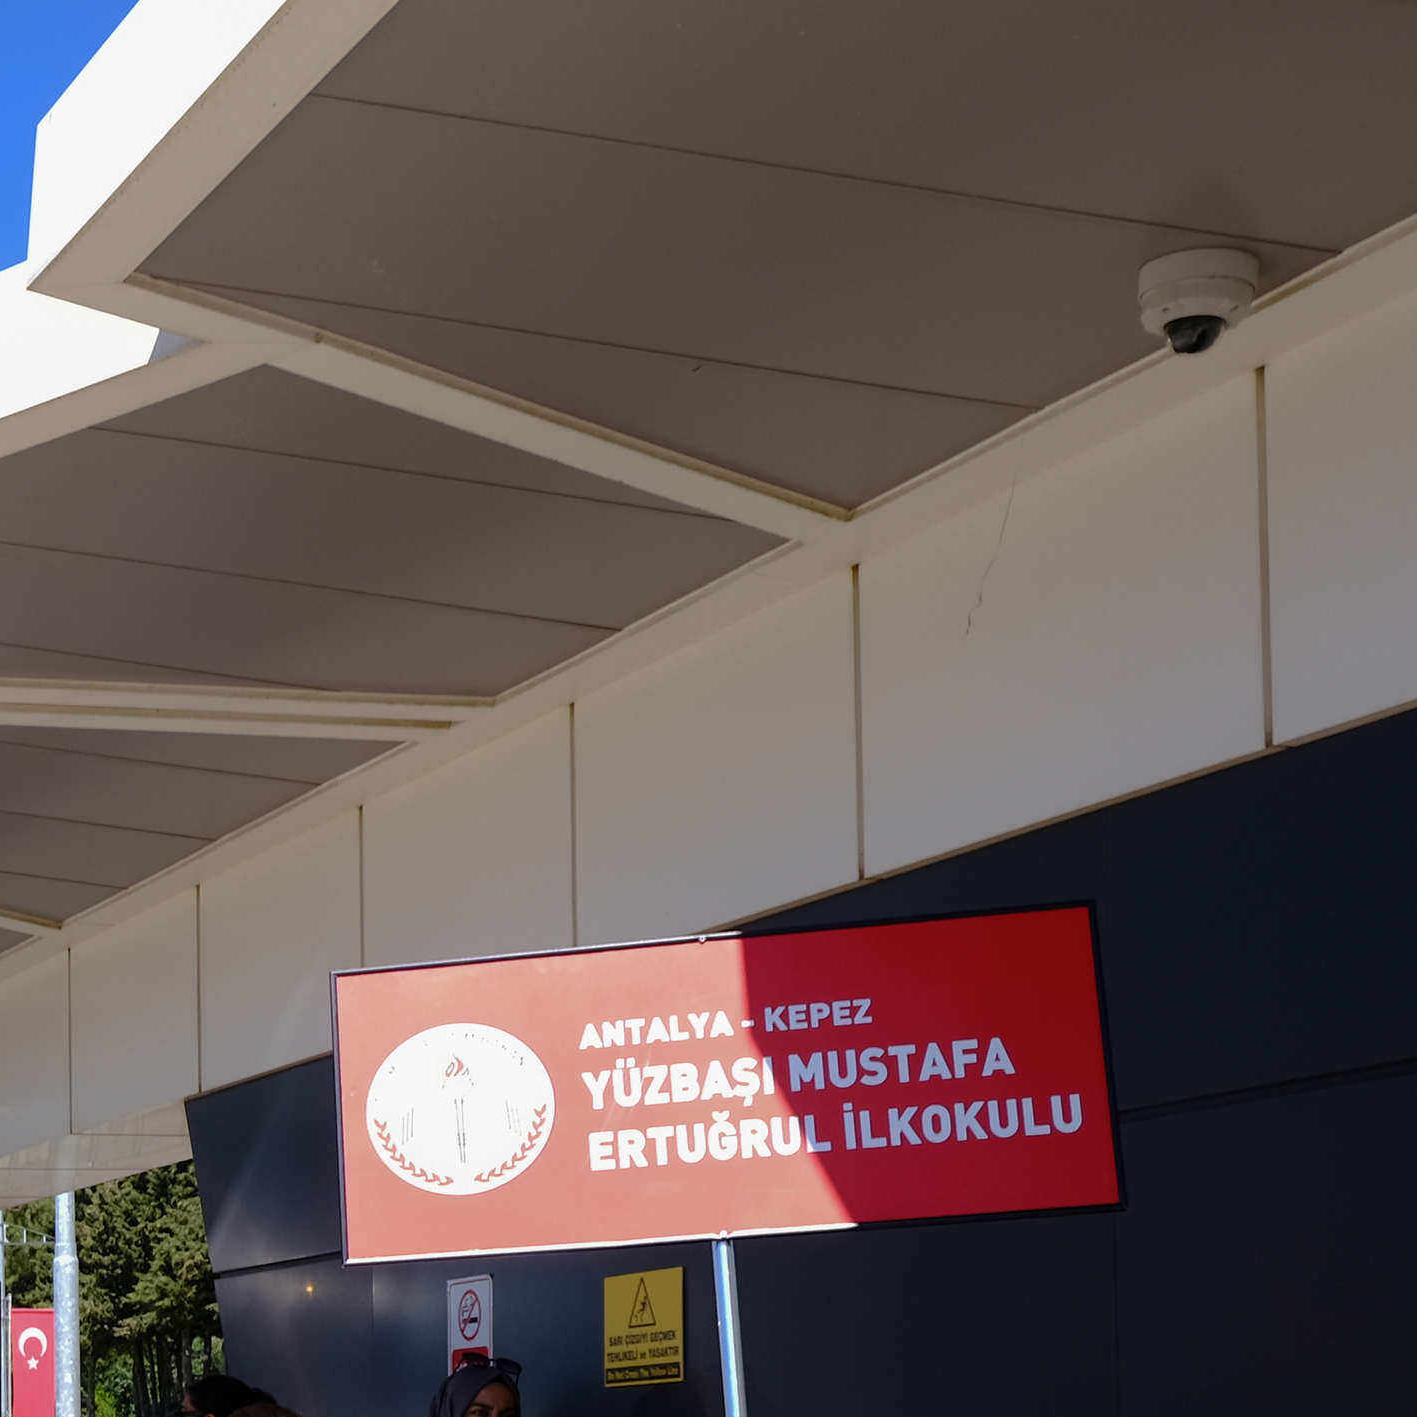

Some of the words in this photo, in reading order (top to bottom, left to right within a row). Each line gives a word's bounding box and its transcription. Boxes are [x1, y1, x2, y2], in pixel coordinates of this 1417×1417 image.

[578, 1009, 735, 1051] ANTALYA
[764, 997, 874, 1033] KEPEZ
[581, 1056, 776, 1111] YÜZBAŞI
[788, 1036, 1016, 1091] MUSTAFA
[588, 1109, 833, 1172] ERTUĞRUL
[843, 1093, 1084, 1151] İLKOKULU
